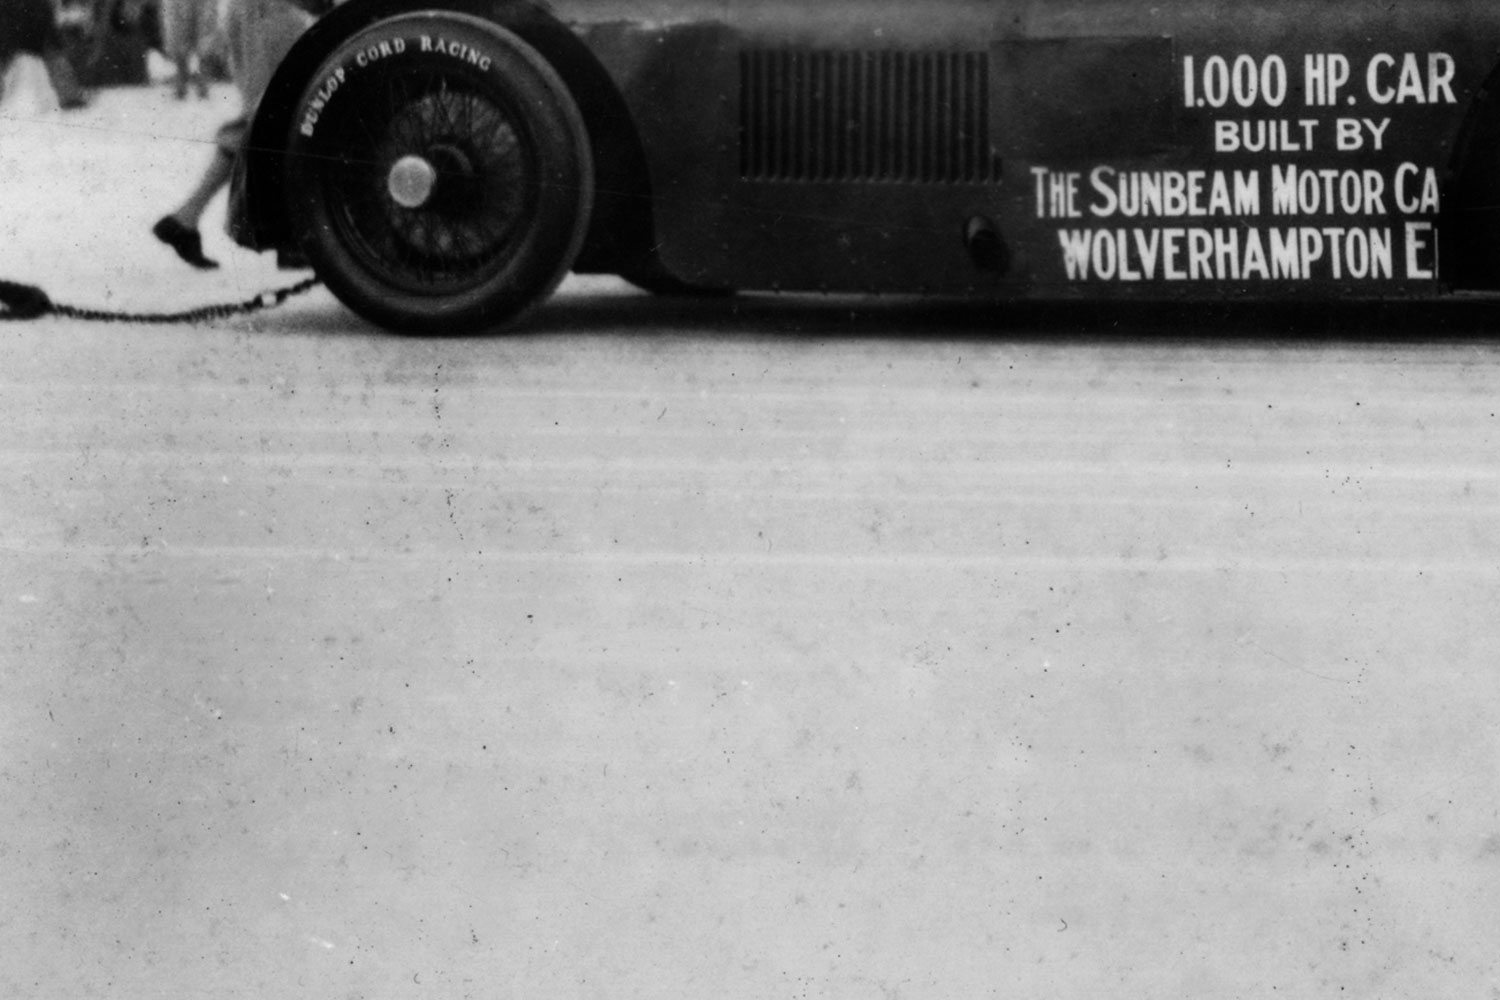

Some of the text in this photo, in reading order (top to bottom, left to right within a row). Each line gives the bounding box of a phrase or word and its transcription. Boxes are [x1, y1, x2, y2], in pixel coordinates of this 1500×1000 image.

[299, 34, 493, 137] DUNLOP CORD RACING
[1366, 51, 1457, 104] CAR
[1214, 116, 1391, 152] BUILT BY
[1029, 166, 1083, 218] THE
[1089, 164, 1261, 217] SUNBEAM
[1271, 163, 1387, 216] MOTOR
[1057, 220, 1439, 281] WOLVERHAMPTON E
